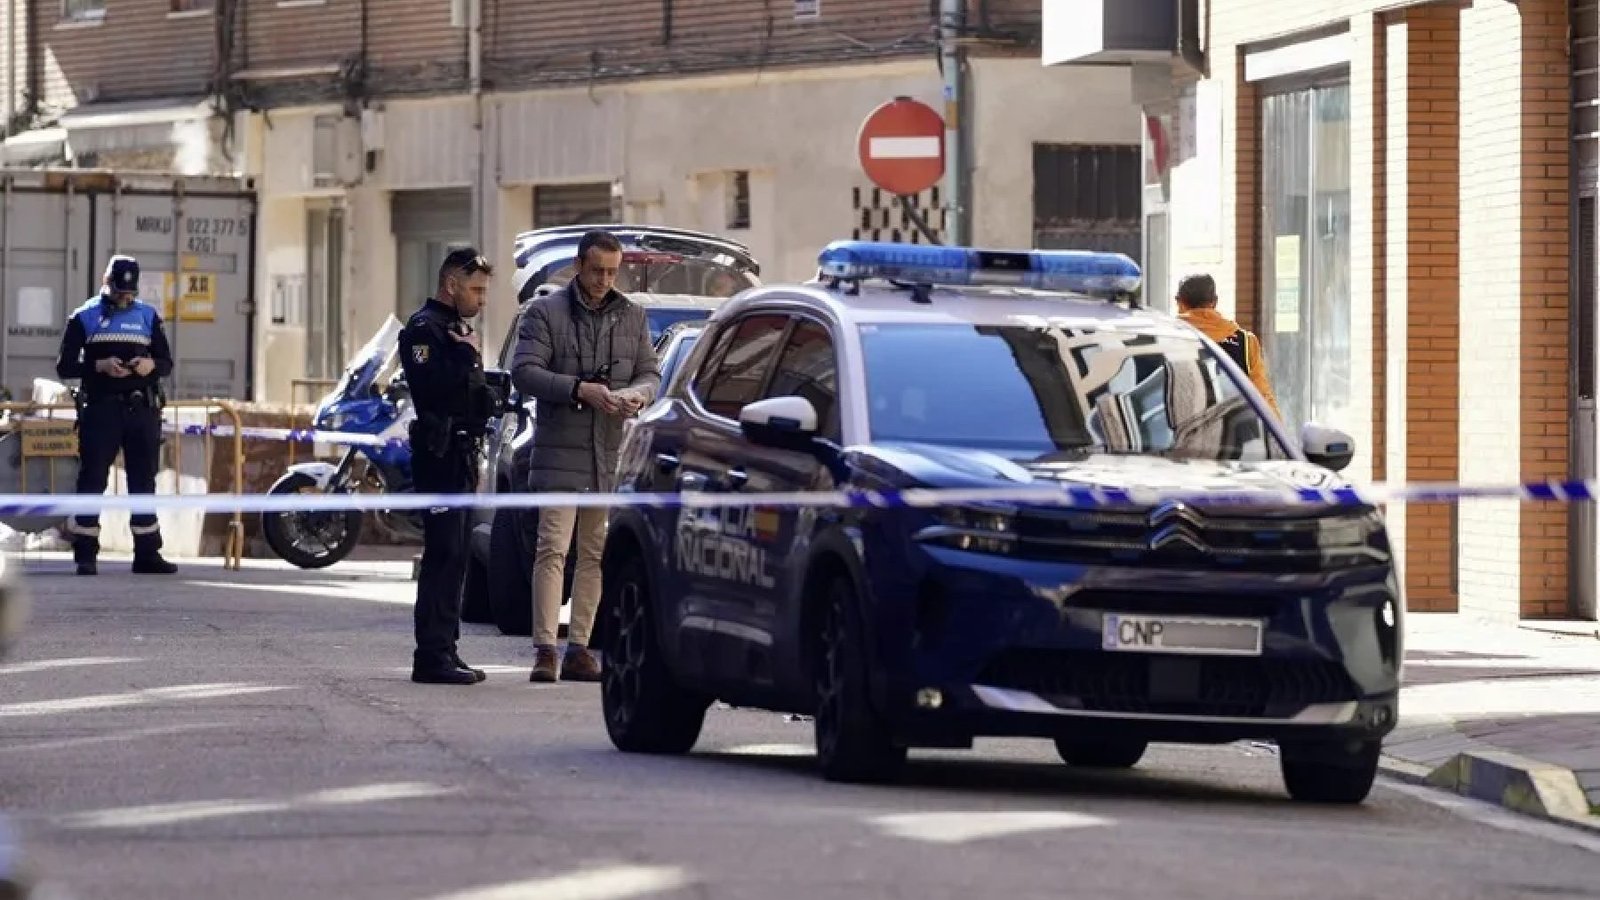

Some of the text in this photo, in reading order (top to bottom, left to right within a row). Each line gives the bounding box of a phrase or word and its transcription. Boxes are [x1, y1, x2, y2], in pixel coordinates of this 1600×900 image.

[186, 217, 210, 235] 022
[212, 218, 235, 237] 377
[676, 530, 776, 589] NACIONAL
[1119, 620, 1164, 645] CNP
